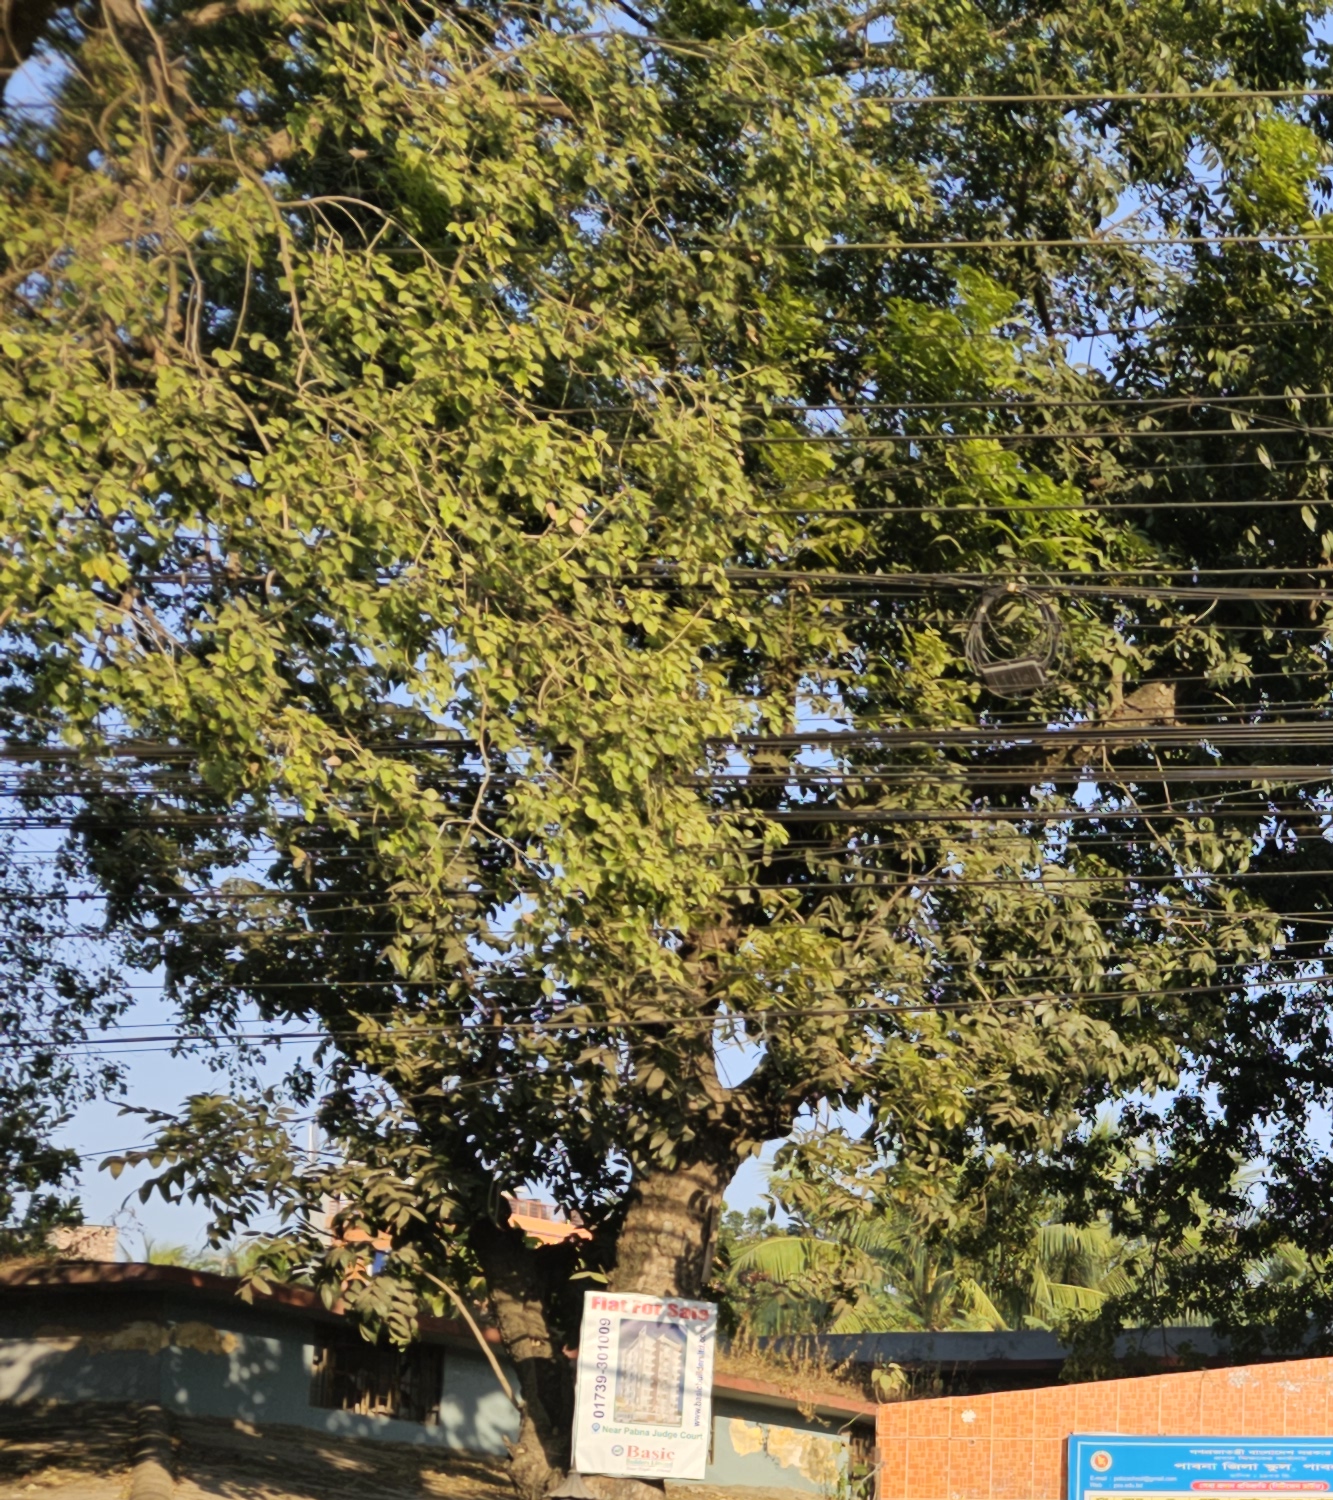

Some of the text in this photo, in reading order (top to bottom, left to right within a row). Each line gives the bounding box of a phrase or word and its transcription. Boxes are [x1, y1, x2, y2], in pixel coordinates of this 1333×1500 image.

[591, 1296, 628, 1313] Flat
[631, 1299, 664, 1316] For
[602, 1425, 703, 1440] Near Pabna Judge Court
[627, 1444, 675, 1461] Basic
[1174, 1462, 1217, 1471] পাবনা
[1222, 1460, 1258, 1471] জিলা
